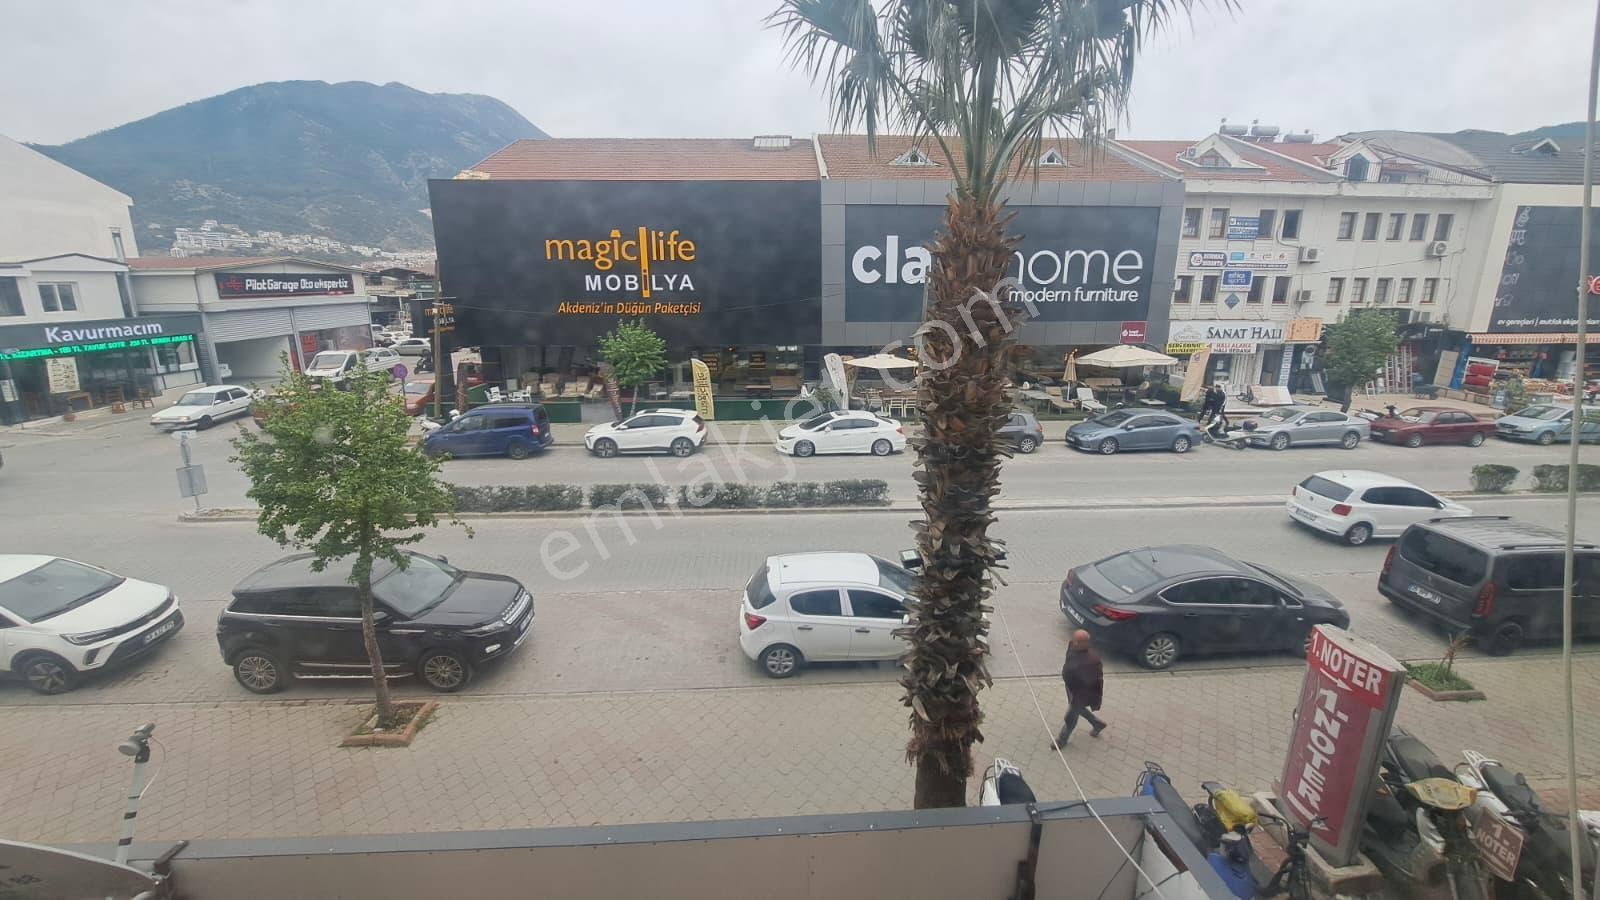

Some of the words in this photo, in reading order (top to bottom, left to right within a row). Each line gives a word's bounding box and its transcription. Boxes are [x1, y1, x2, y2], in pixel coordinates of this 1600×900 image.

[545, 229, 638, 270] magic
[651, 230, 696, 261] life
[1008, 287, 1071, 302] modern
[1073, 286, 1139, 302] furniture
[559, 302, 613, 314] Akdeniz'in
[616, 301, 651, 317] Düğün
[654, 302, 702, 317] Paketçisi
[45, 322, 163, 343] Kavurmacım
[1206, 326, 1248, 339] SANAT
